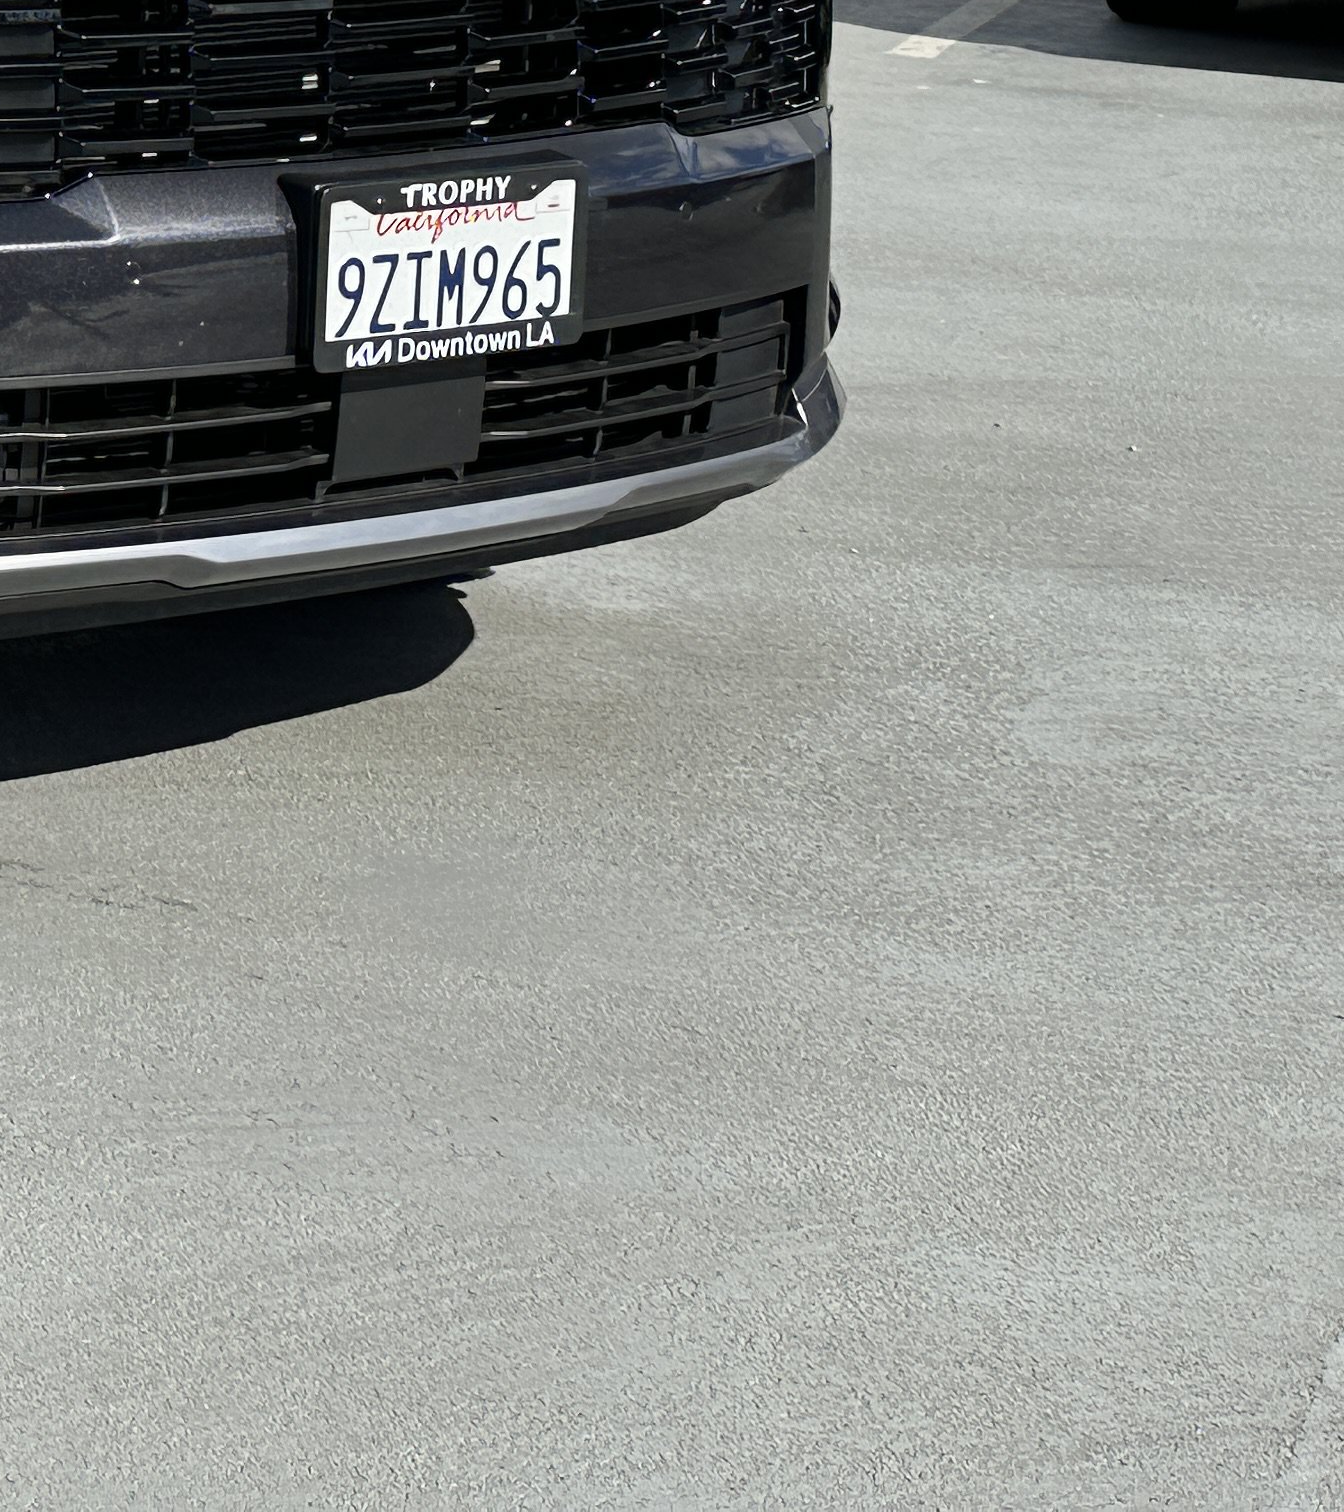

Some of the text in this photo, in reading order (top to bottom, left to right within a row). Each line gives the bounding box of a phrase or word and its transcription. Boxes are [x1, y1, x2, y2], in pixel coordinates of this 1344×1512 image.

[400, 175, 512, 208] TROPHY
[334, 237, 562, 339] 9ZIM965
[345, 320, 555, 369] KIA Downtown LA
